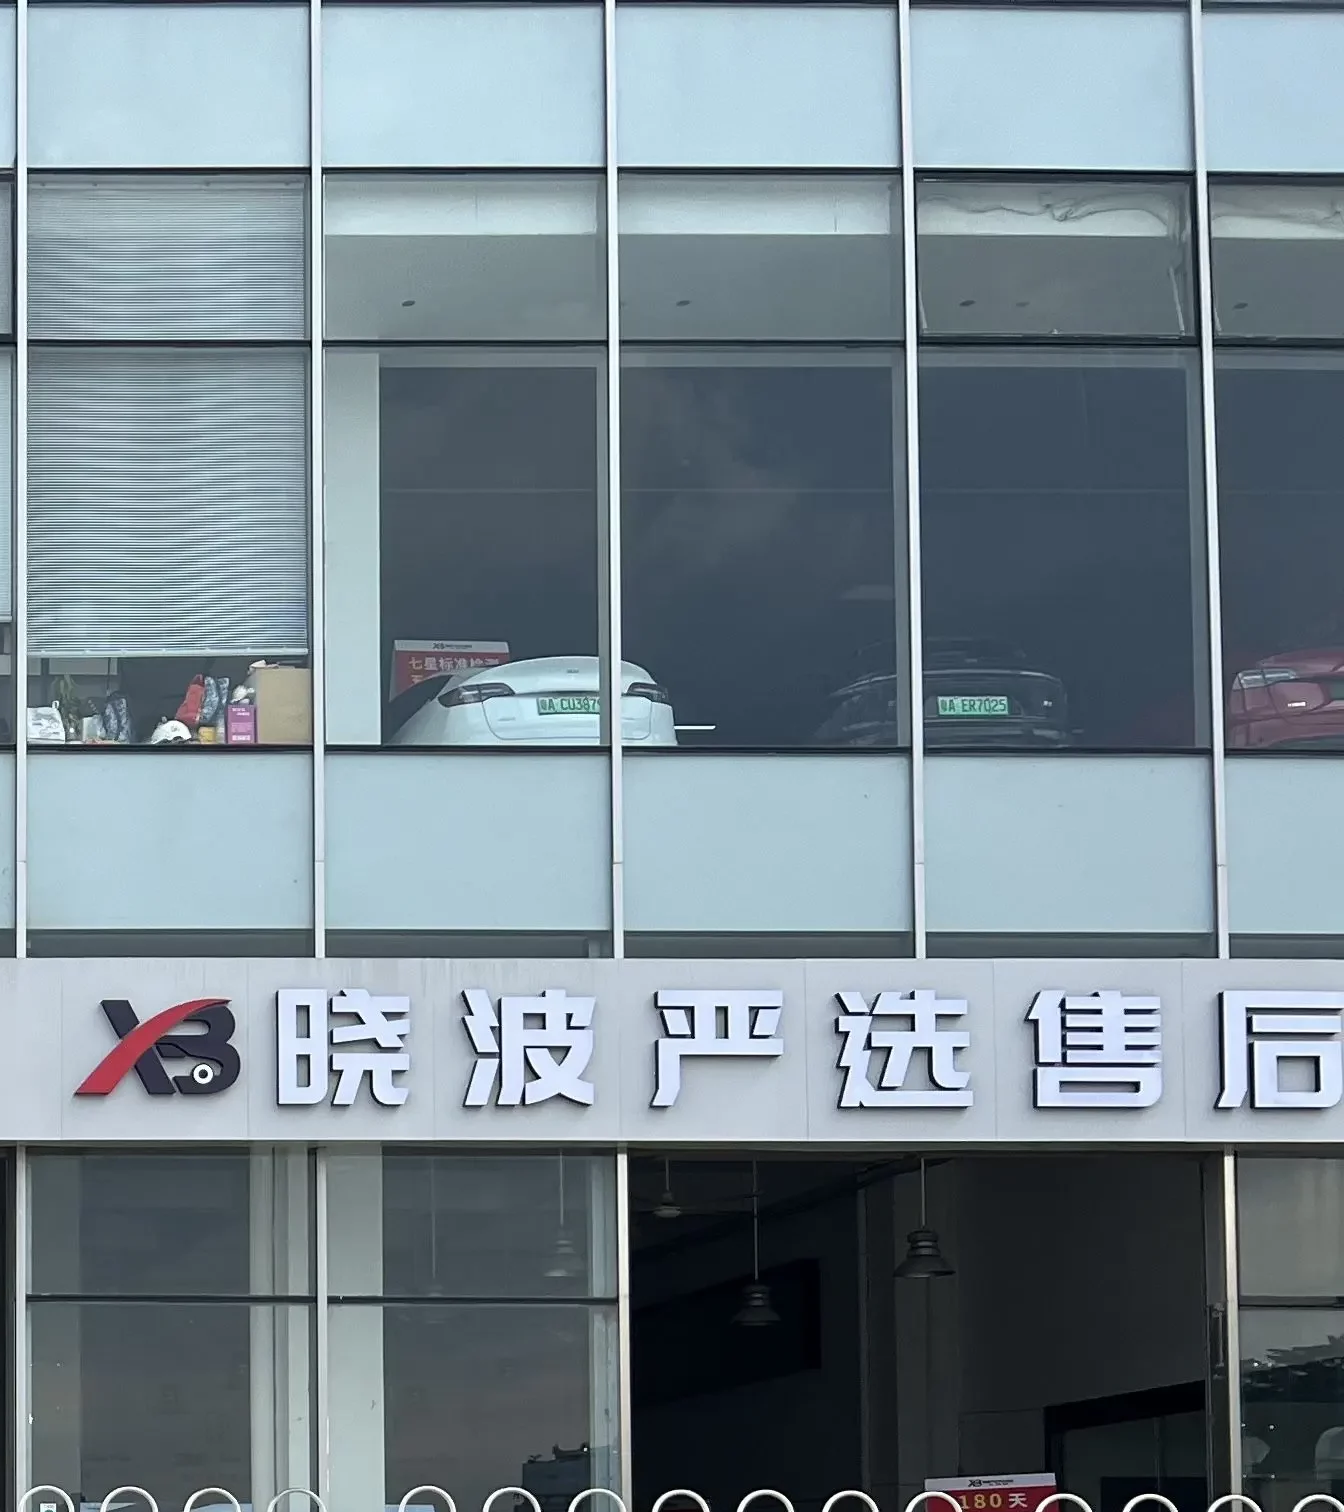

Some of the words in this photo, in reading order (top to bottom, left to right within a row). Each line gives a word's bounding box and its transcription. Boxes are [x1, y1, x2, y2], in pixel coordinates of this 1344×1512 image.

[275, 986, 1344, 1110] 晓波严选售后
